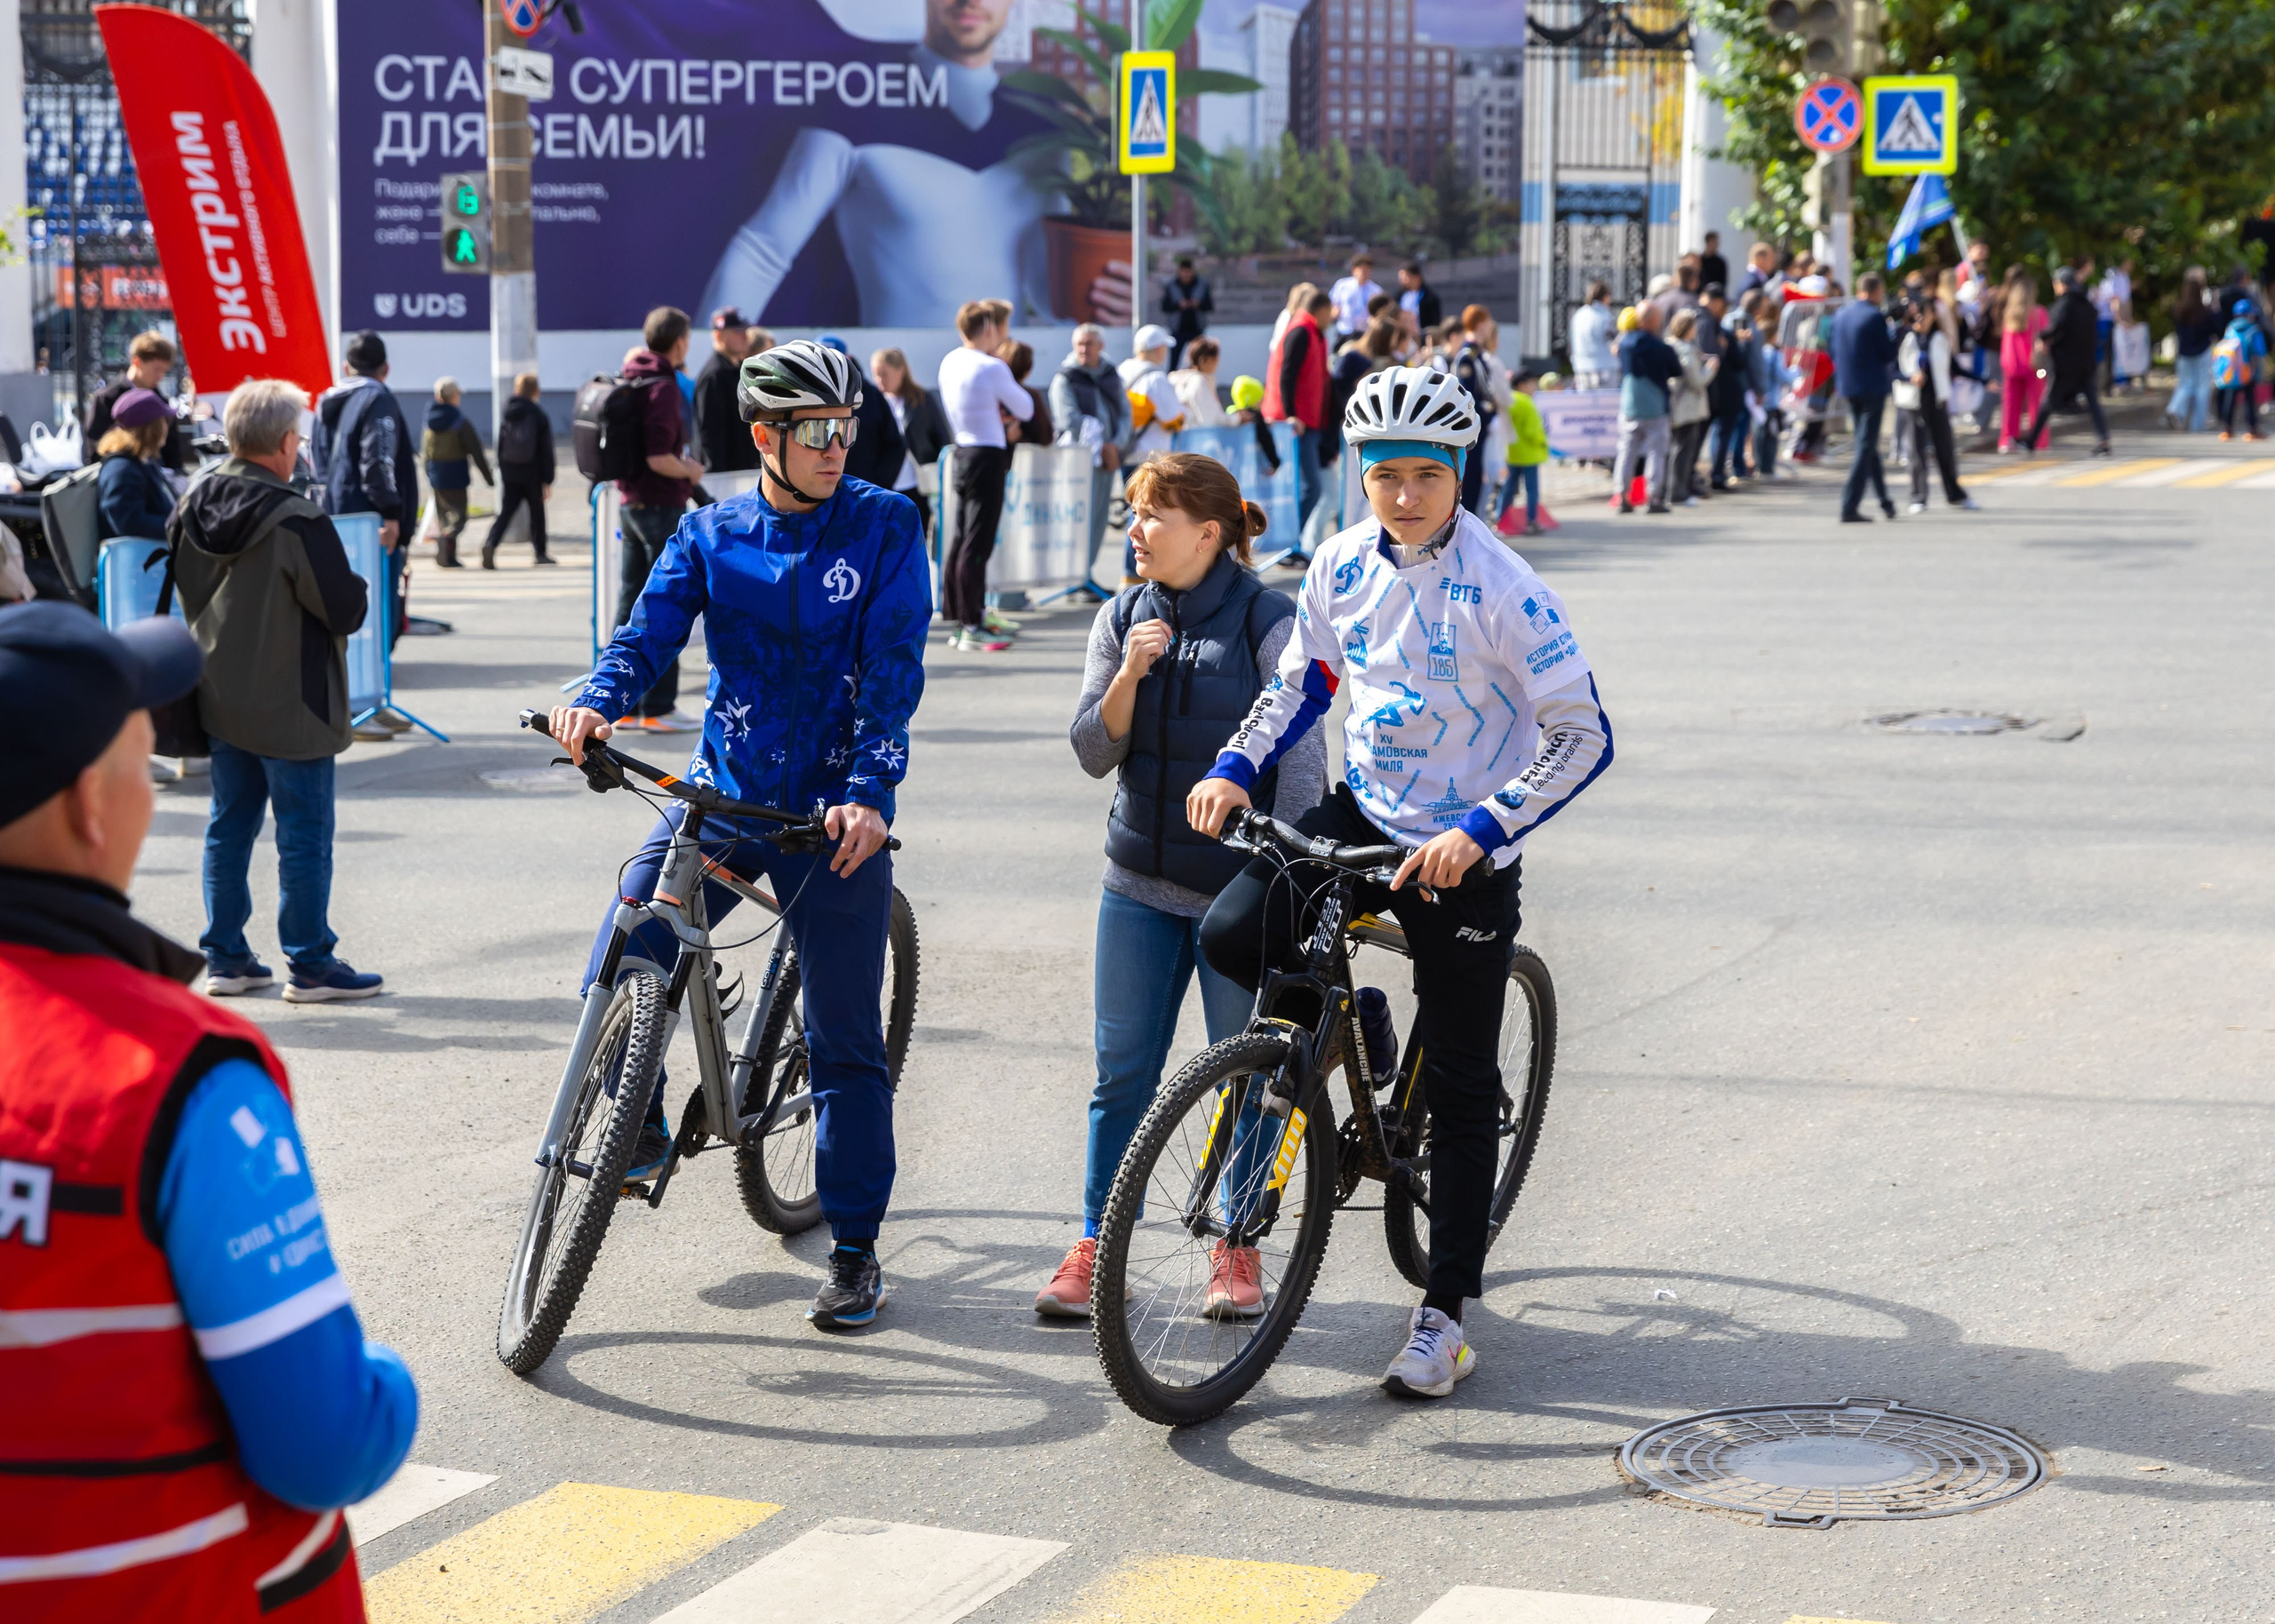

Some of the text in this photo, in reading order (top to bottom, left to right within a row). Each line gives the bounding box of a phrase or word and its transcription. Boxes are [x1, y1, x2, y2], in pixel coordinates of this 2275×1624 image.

[374, 54, 947, 108] СТА СУПЕРГЕРОЕМ
[373, 111, 487, 167] ДЛЯ
[402, 293, 467, 317] UDS
[1450, 583, 1482, 605] ВТБ
[1526, 639, 1560, 665] ИСТОРИЯ
[1530, 651, 1565, 675] ИСТОРИЯ
[1433, 657, 1454, 678] 185
[1367, 743, 1427, 758] АМОВСКАЯ
[1379, 734, 1393, 744] XV
[1375, 759, 1403, 773] МИЛЯ
[1531, 736, 1583, 792] Leading brands
[1456, 926, 1497, 942] FILA
[761, 951, 776, 987] GoPro
[1352, 1017, 1369, 1082] AVALANCHE
